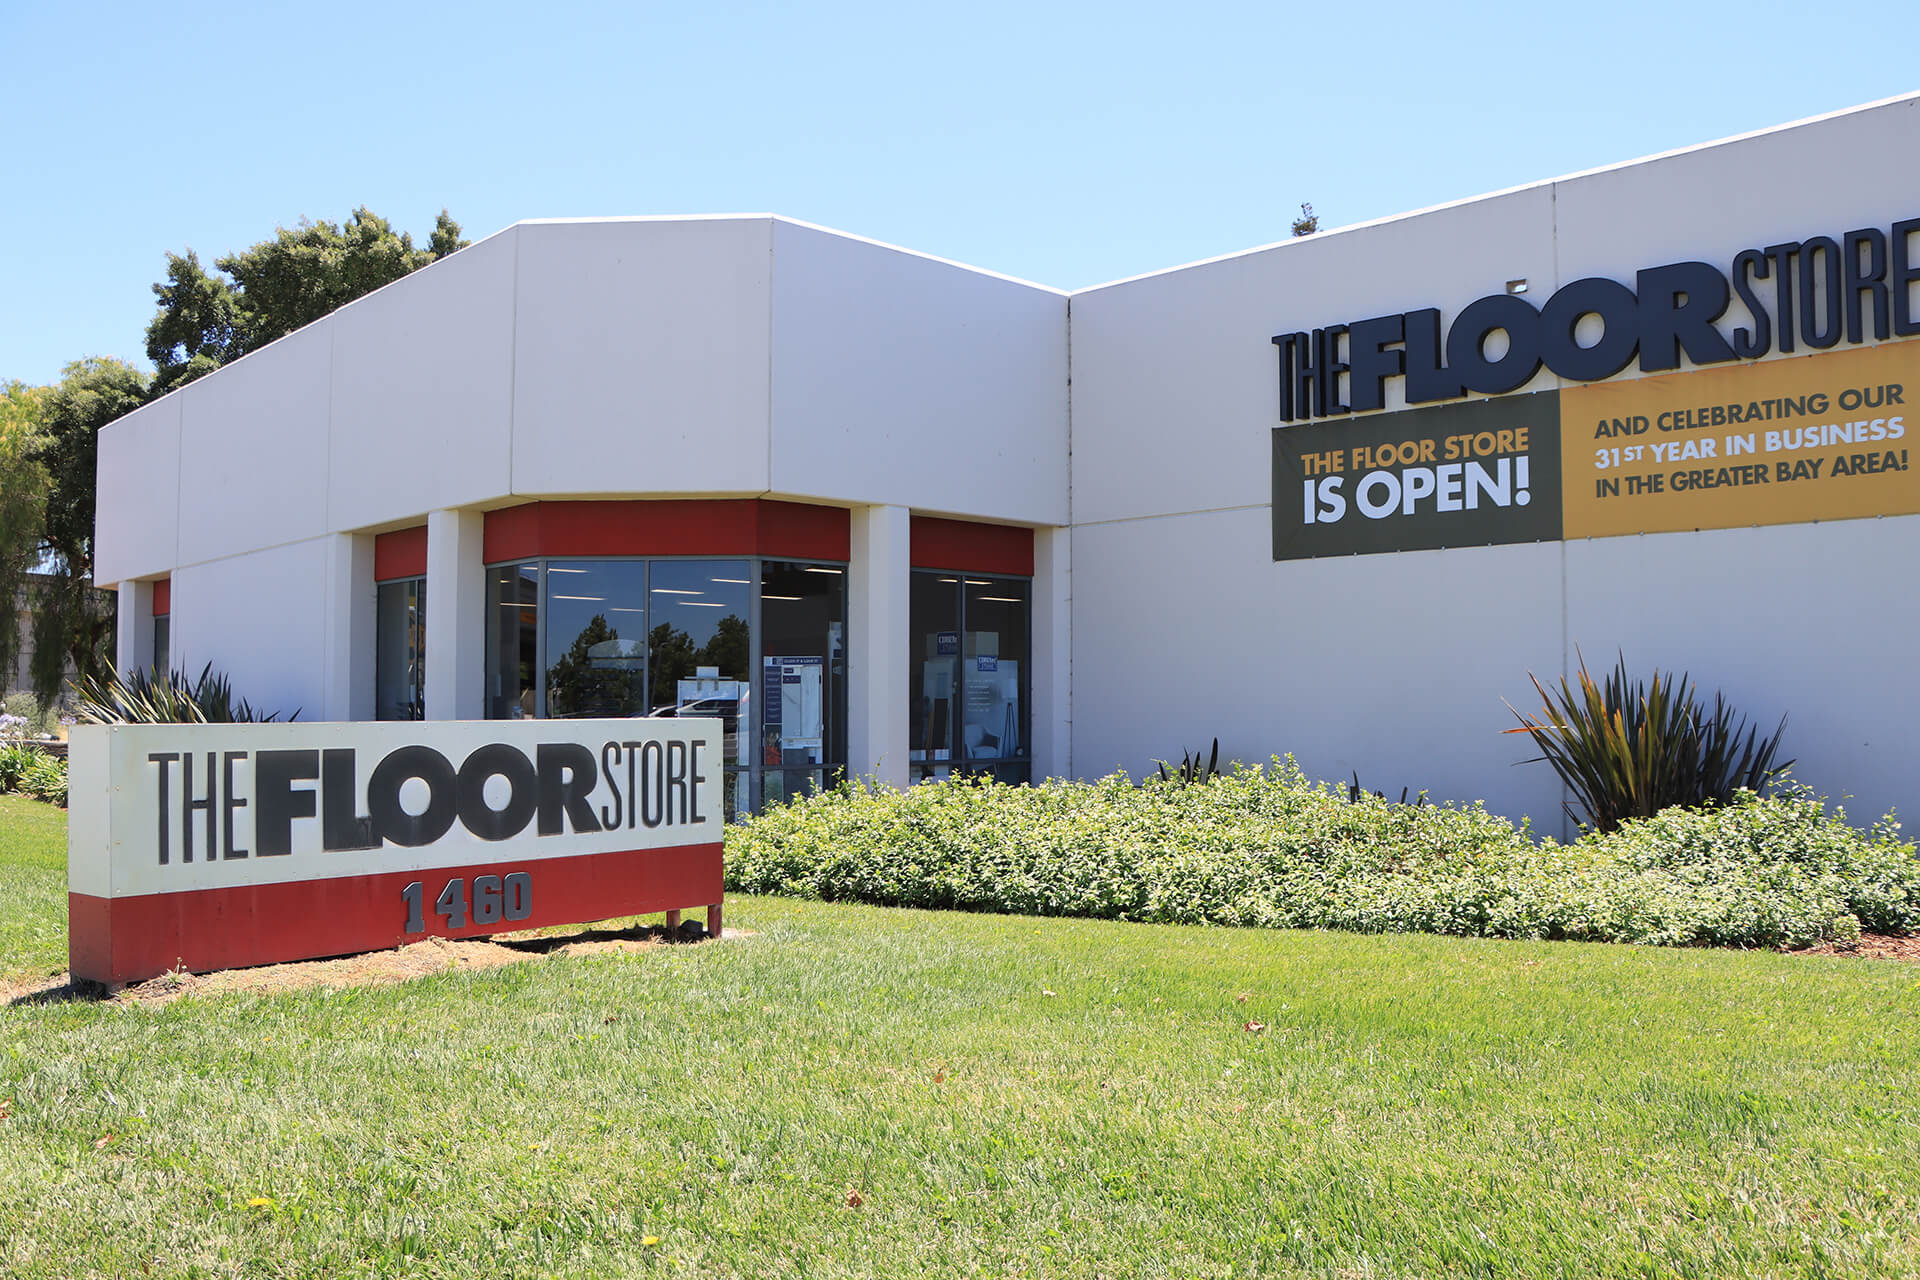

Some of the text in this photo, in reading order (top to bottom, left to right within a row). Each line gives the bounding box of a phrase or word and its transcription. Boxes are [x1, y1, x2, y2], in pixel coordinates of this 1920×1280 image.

[1272, 218, 1920, 421] THE FLOOR STORE
[1594, 384, 1905, 440] AND CELEBRATING OUR
[1649, 438, 1717, 463] YEAR
[1725, 433, 1756, 457] IN
[1764, 416, 1905, 453] BUSINESS
[1300, 427, 1529, 476] THE FLOOR STORE
[1595, 449, 1909, 498] IN THE GREATER BAY AREA!
[1303, 455, 1531, 525] IS OPEN!
[148, 739, 706, 865] THE FLOOR STORE
[401, 871, 532, 934] 1460
